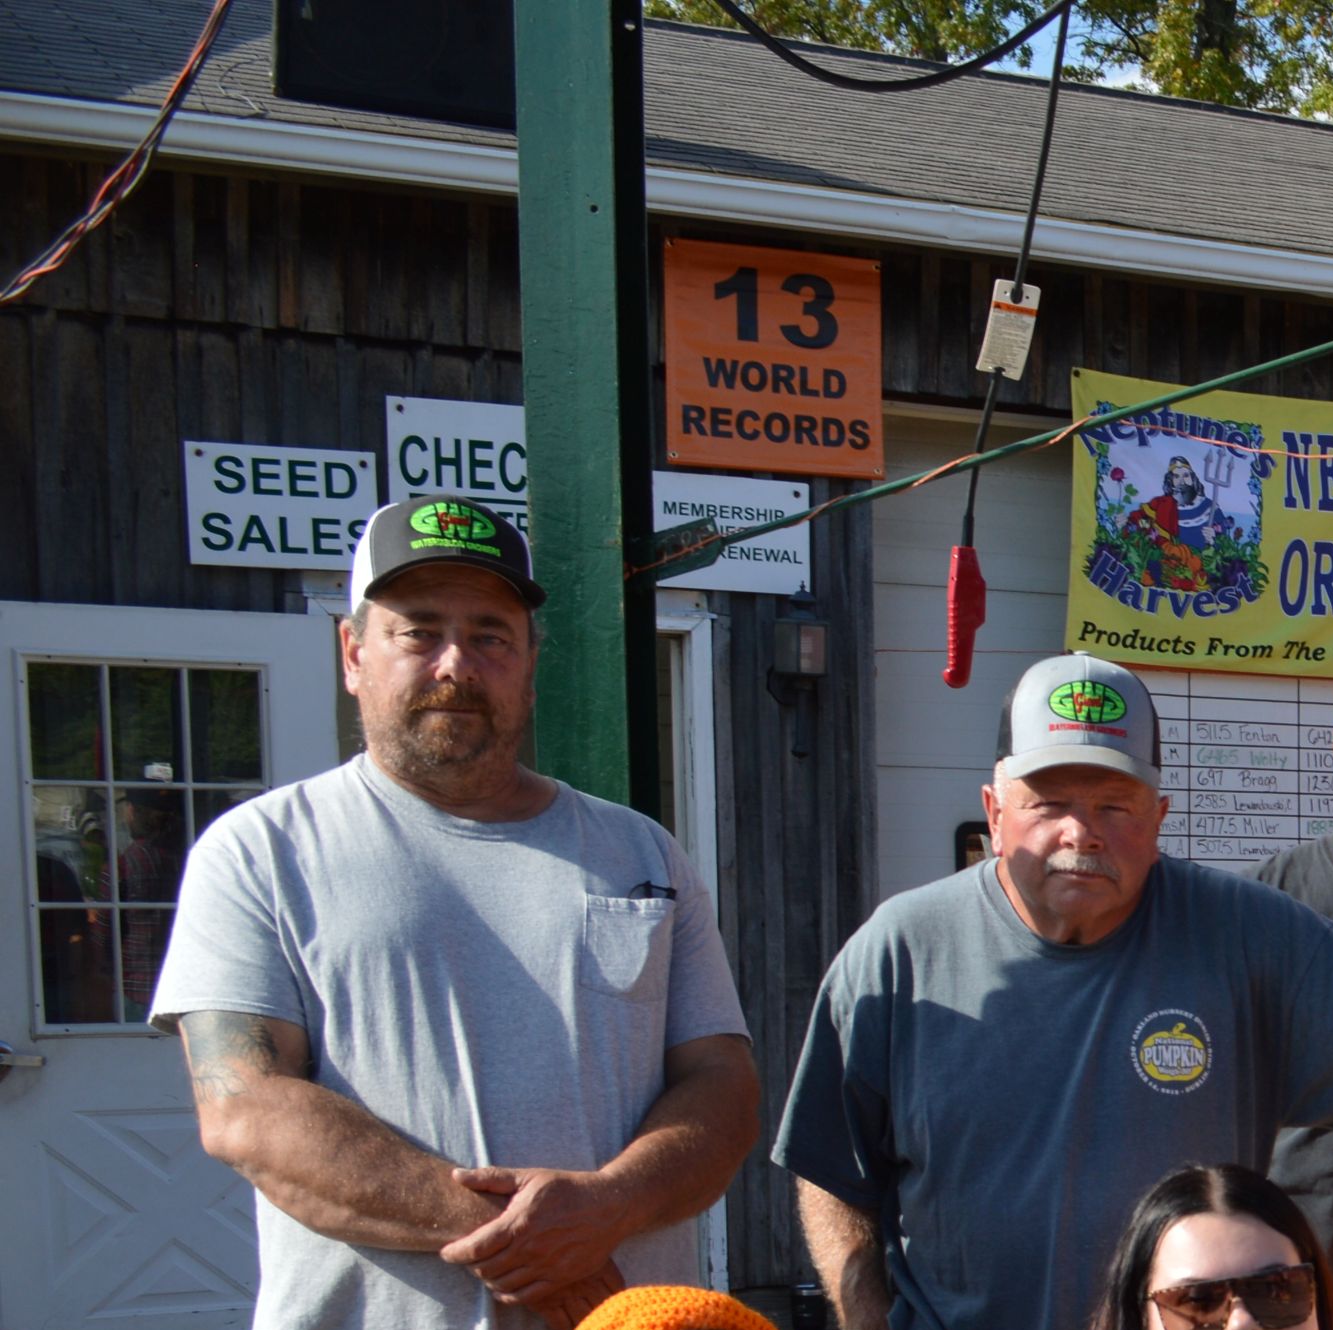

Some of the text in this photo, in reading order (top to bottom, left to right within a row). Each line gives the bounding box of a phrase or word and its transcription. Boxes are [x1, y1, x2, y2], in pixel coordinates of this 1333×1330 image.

[714, 266, 838, 350] 13
[702, 356, 847, 399] WORLD
[681, 404, 871, 450] RECORDS
[214, 456, 358, 499] SEED
[663, 501, 785, 521] MEMBERSHIP
[201, 512, 367, 556] SALES
[1089, 550, 1260, 619] Harvest
[1078, 621, 1196, 656] Products
[1205, 637, 1274, 659] From
[1282, 640, 1326, 661] The
[1197, 768, 1223, 786] 697
[1196, 817, 1237, 835] 477.5
[1143, 1044, 1204, 1068] PUMPKIN
